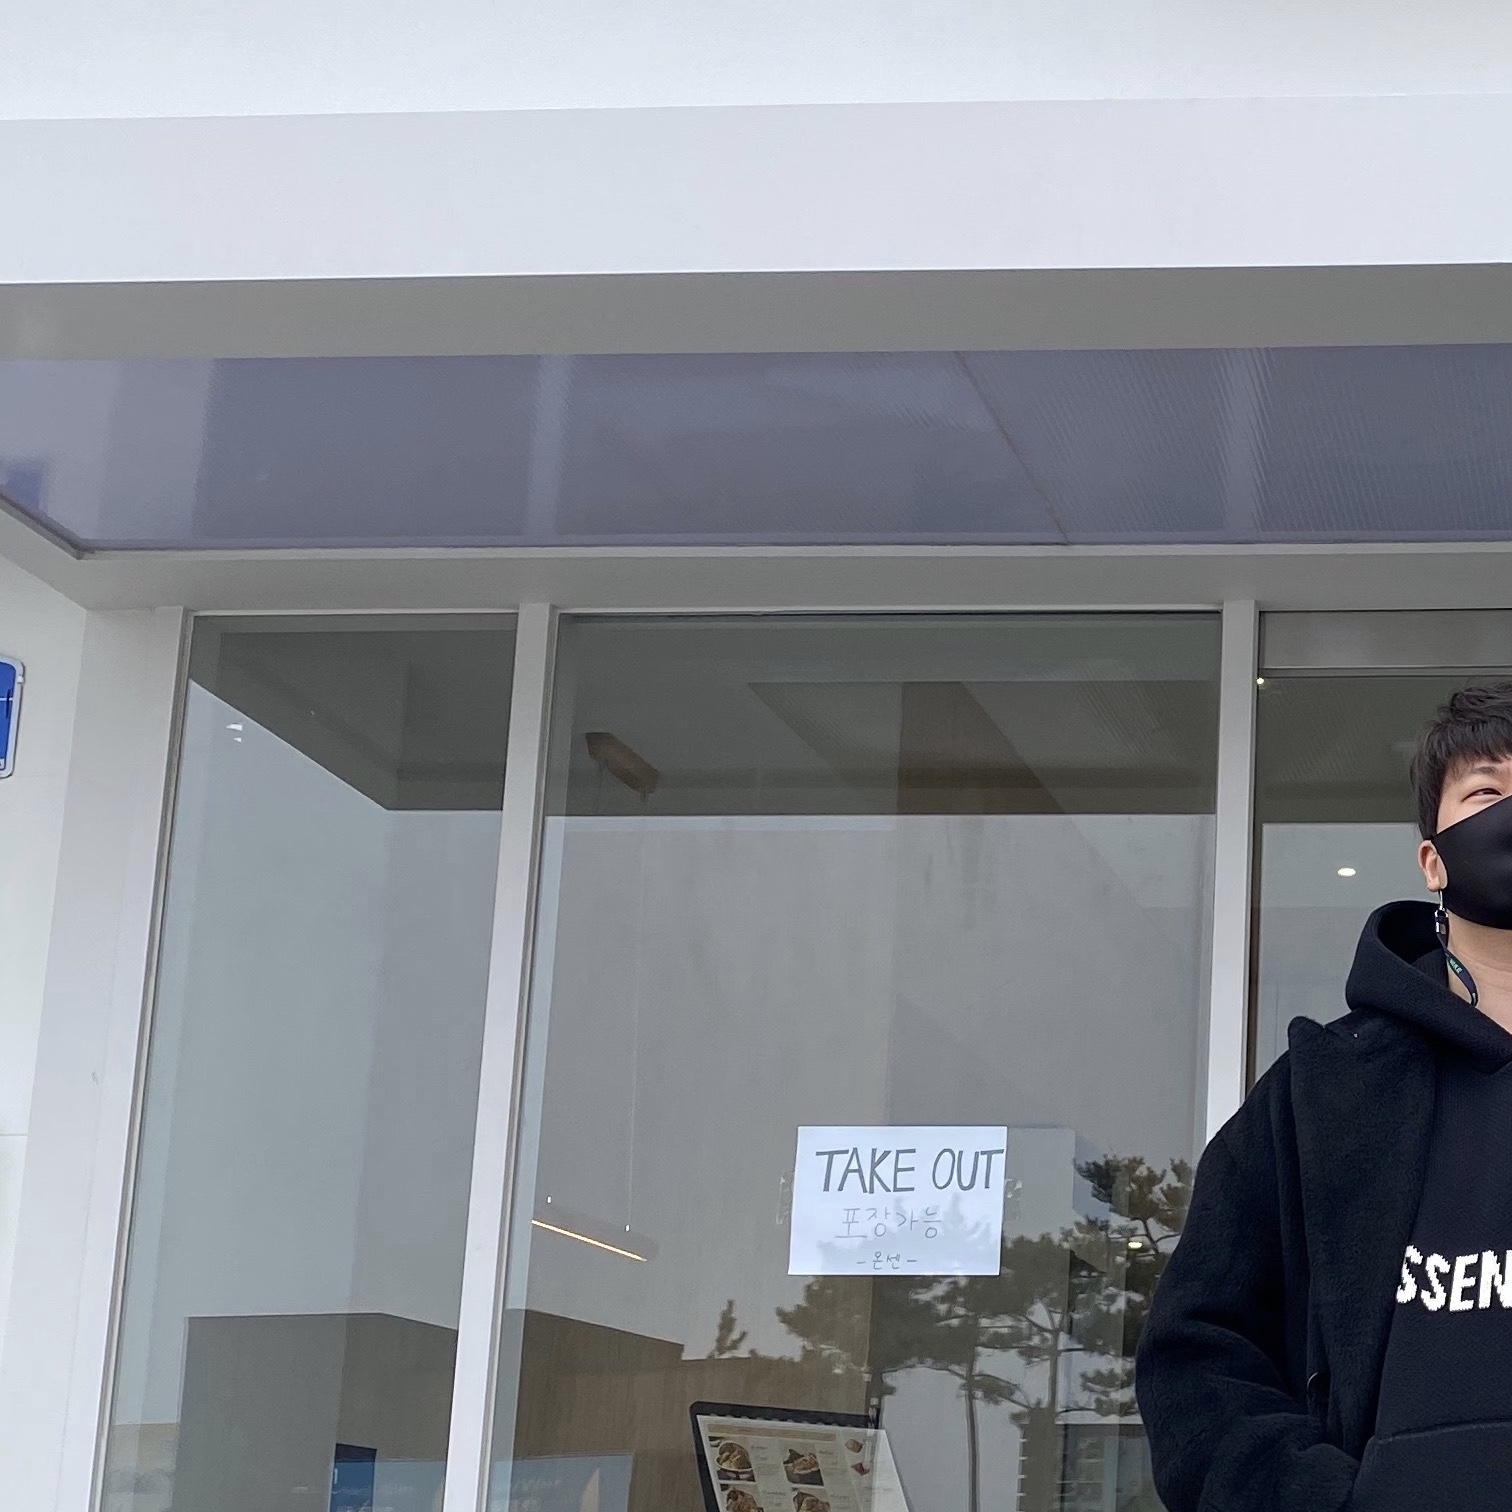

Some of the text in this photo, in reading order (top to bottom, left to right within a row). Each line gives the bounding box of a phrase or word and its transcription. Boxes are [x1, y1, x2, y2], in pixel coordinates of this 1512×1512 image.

[815, 1147, 1005, 1195] TAKE OUT
[834, 1205, 943, 1240] 포장가능
